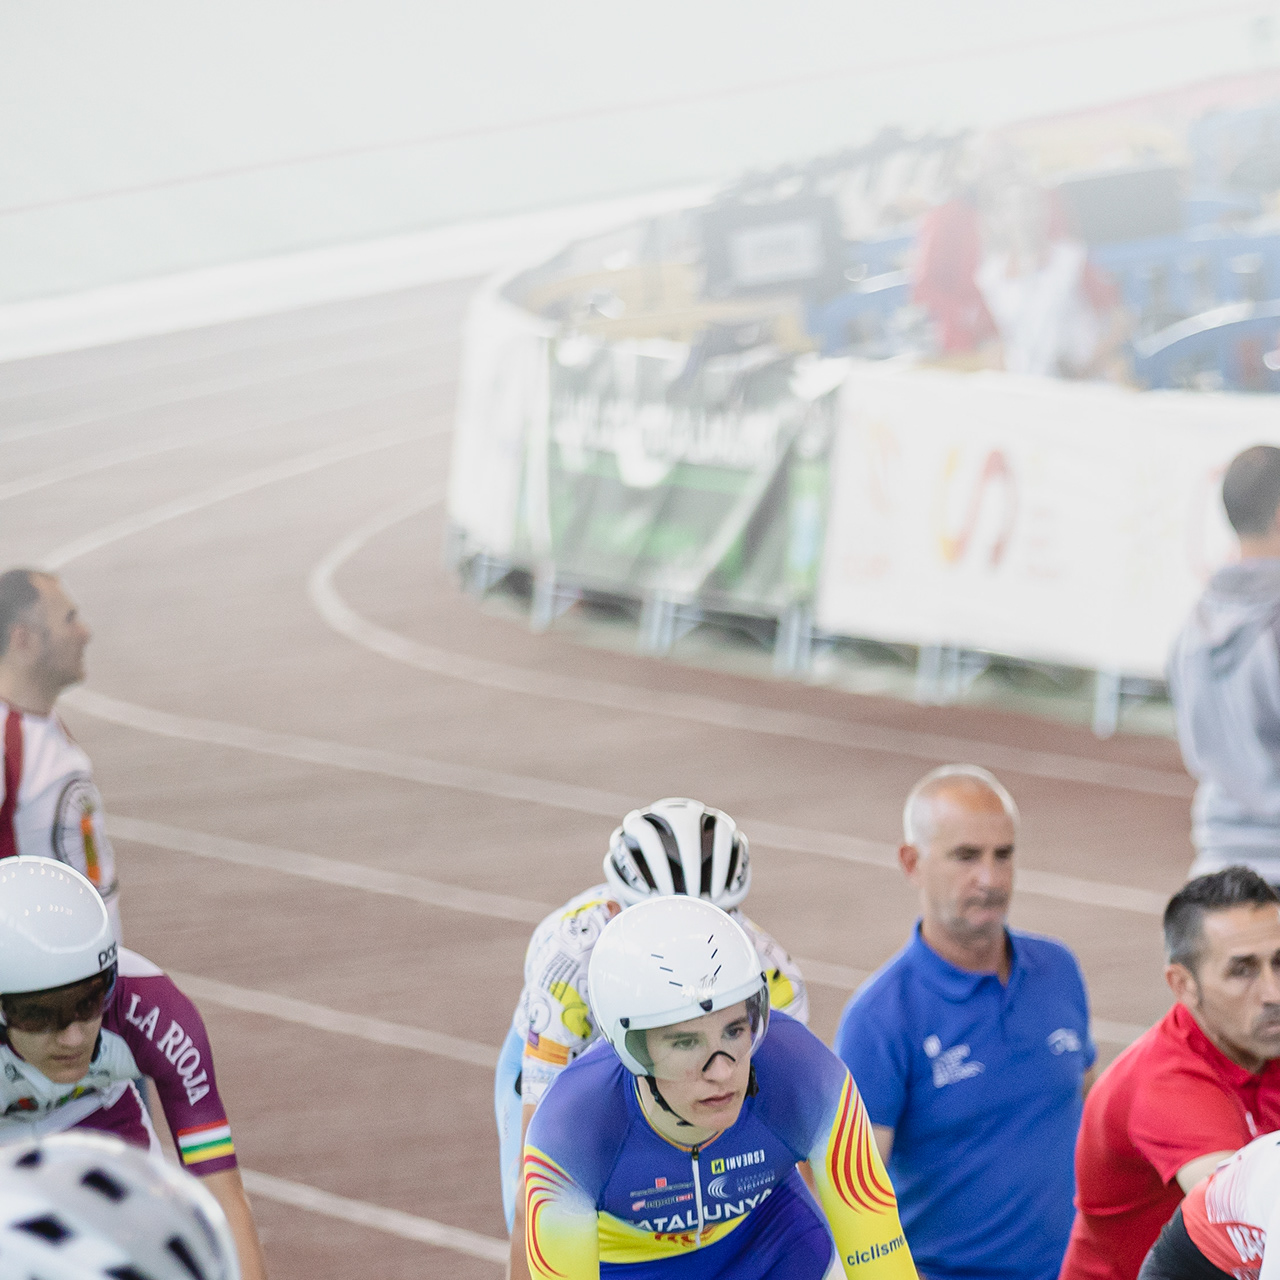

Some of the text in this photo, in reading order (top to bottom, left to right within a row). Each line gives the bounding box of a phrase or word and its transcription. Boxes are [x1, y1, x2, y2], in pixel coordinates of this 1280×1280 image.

[125, 992, 210, 1107] LA RIOJA
[726, 1149, 766, 1171] INVERSE
[629, 1188, 773, 1233] ATALUNYA
